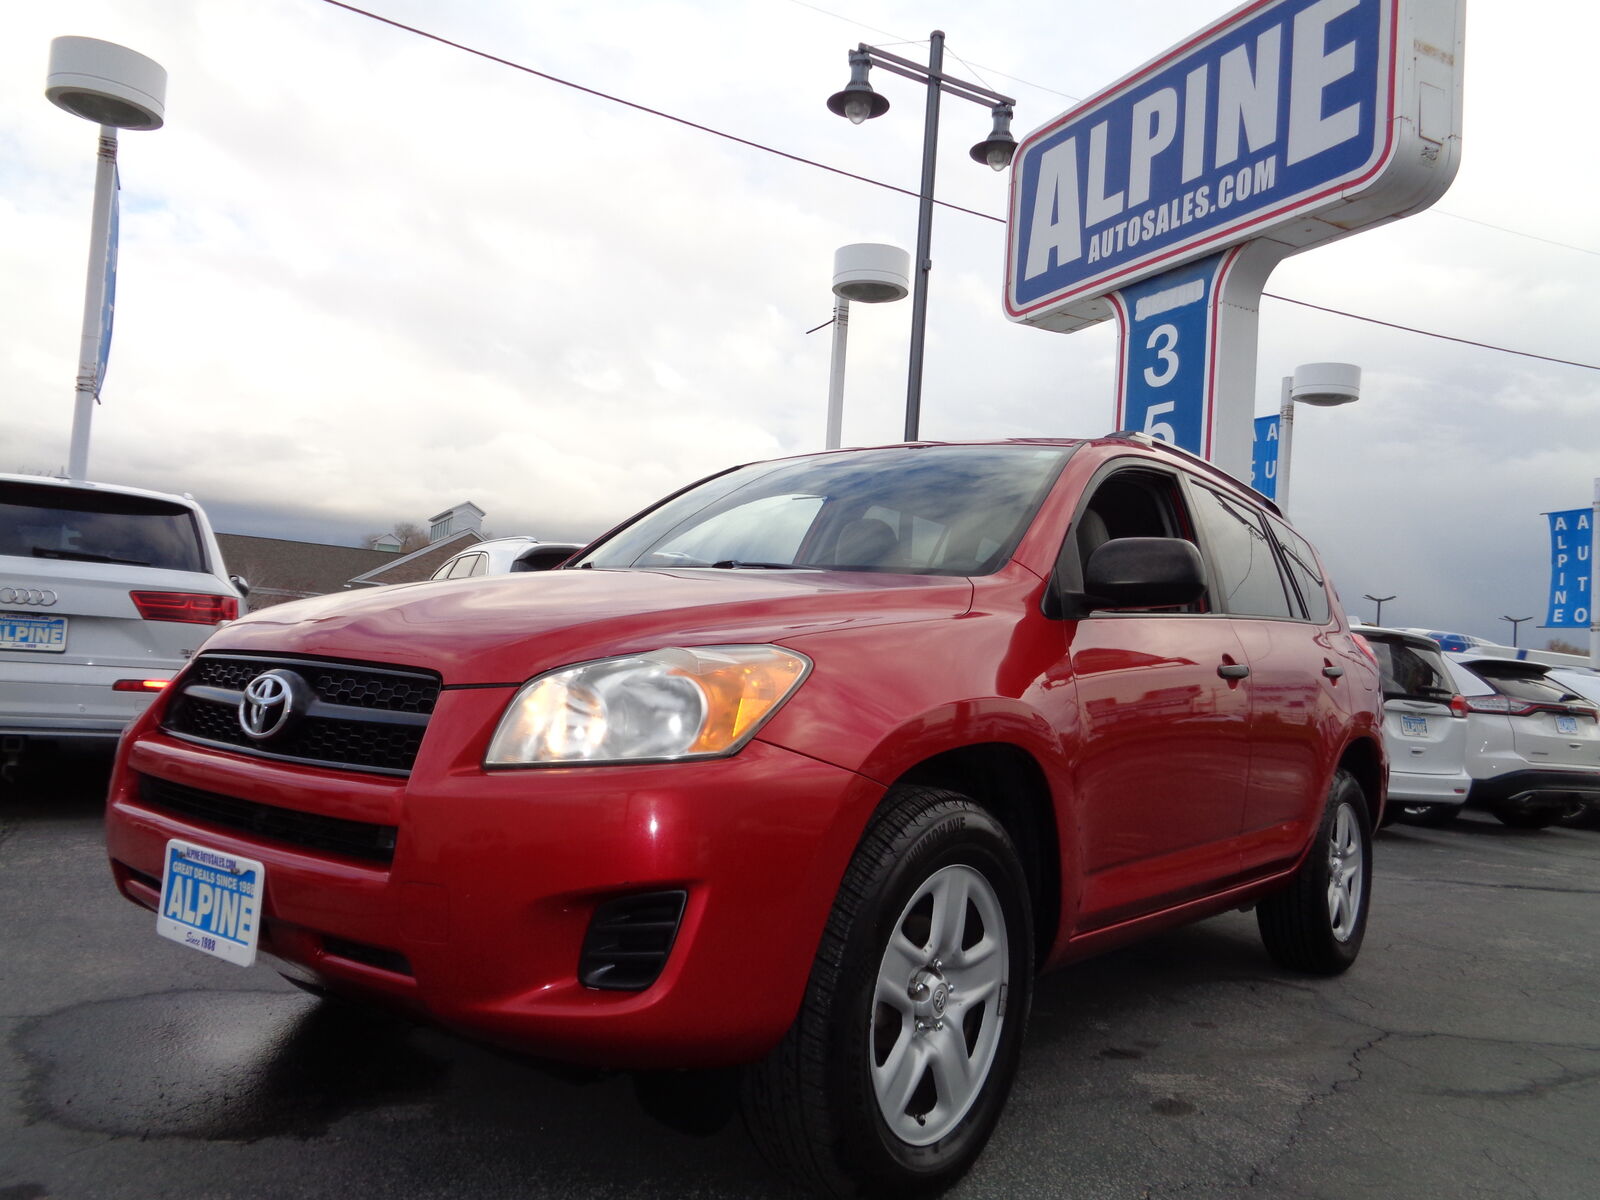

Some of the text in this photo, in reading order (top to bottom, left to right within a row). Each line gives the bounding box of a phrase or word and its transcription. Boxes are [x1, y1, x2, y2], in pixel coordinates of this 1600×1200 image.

[1025, 0, 1361, 281] ALPINE
[1088, 155, 1275, 264] AUTOSALES.COM
[1553, 517, 1567, 623] ALPINE
[1574, 515, 1589, 623] AUTO
[0, 625, 63, 644] LPINE
[166, 875, 256, 940] ALPINE
[216, 873, 238, 890] SINCE
[185, 931, 216, 952] Since 1988
